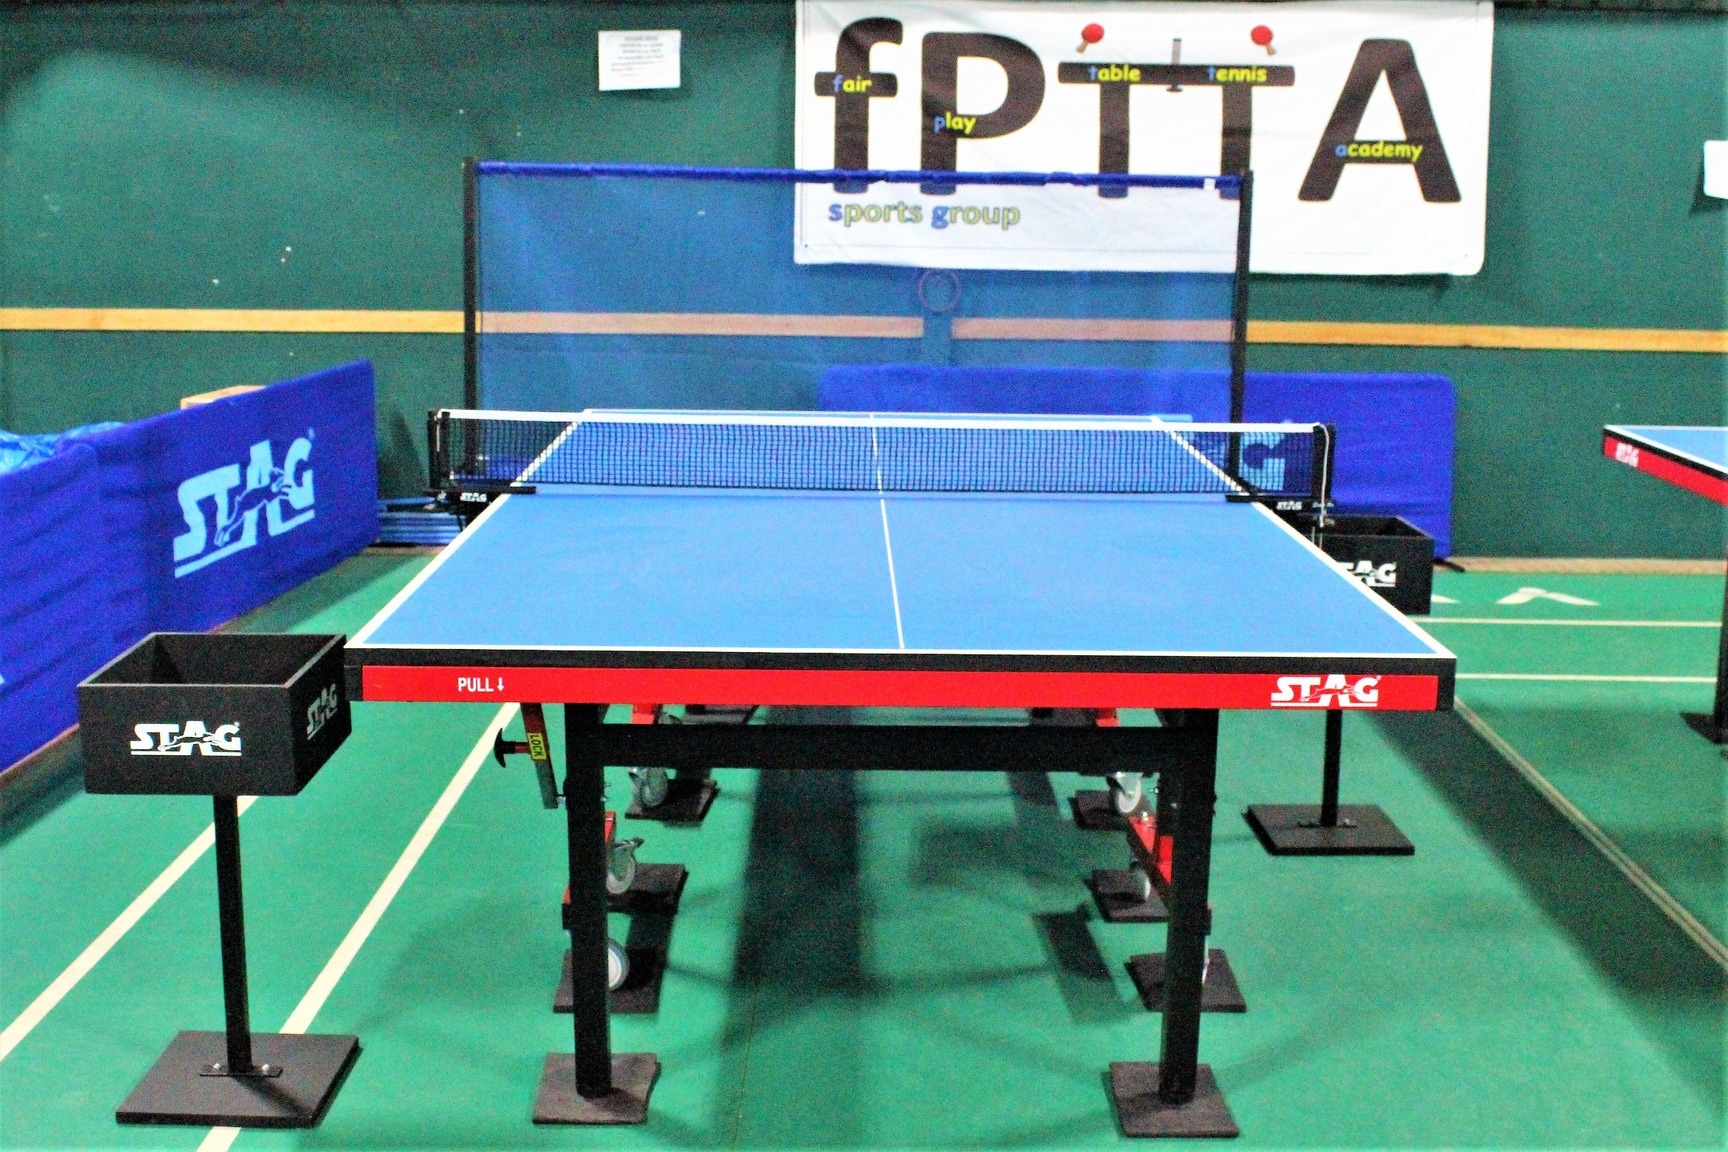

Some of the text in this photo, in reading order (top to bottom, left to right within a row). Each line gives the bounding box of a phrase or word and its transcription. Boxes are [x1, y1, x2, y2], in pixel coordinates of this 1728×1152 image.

[833, 74, 873, 93] fair
[1088, 64, 1267, 82] table tennis
[934, 112, 976, 134] play
[1335, 140, 1423, 162] academy
[828, 201, 1021, 230] sports group
[174, 437, 314, 578] STAG
[457, 677, 494, 692] PULL
[1271, 674, 1378, 708] STAG
[306, 683, 338, 740] STAG
[130, 720, 242, 756] STAG
[530, 734, 544, 757] LOCK
